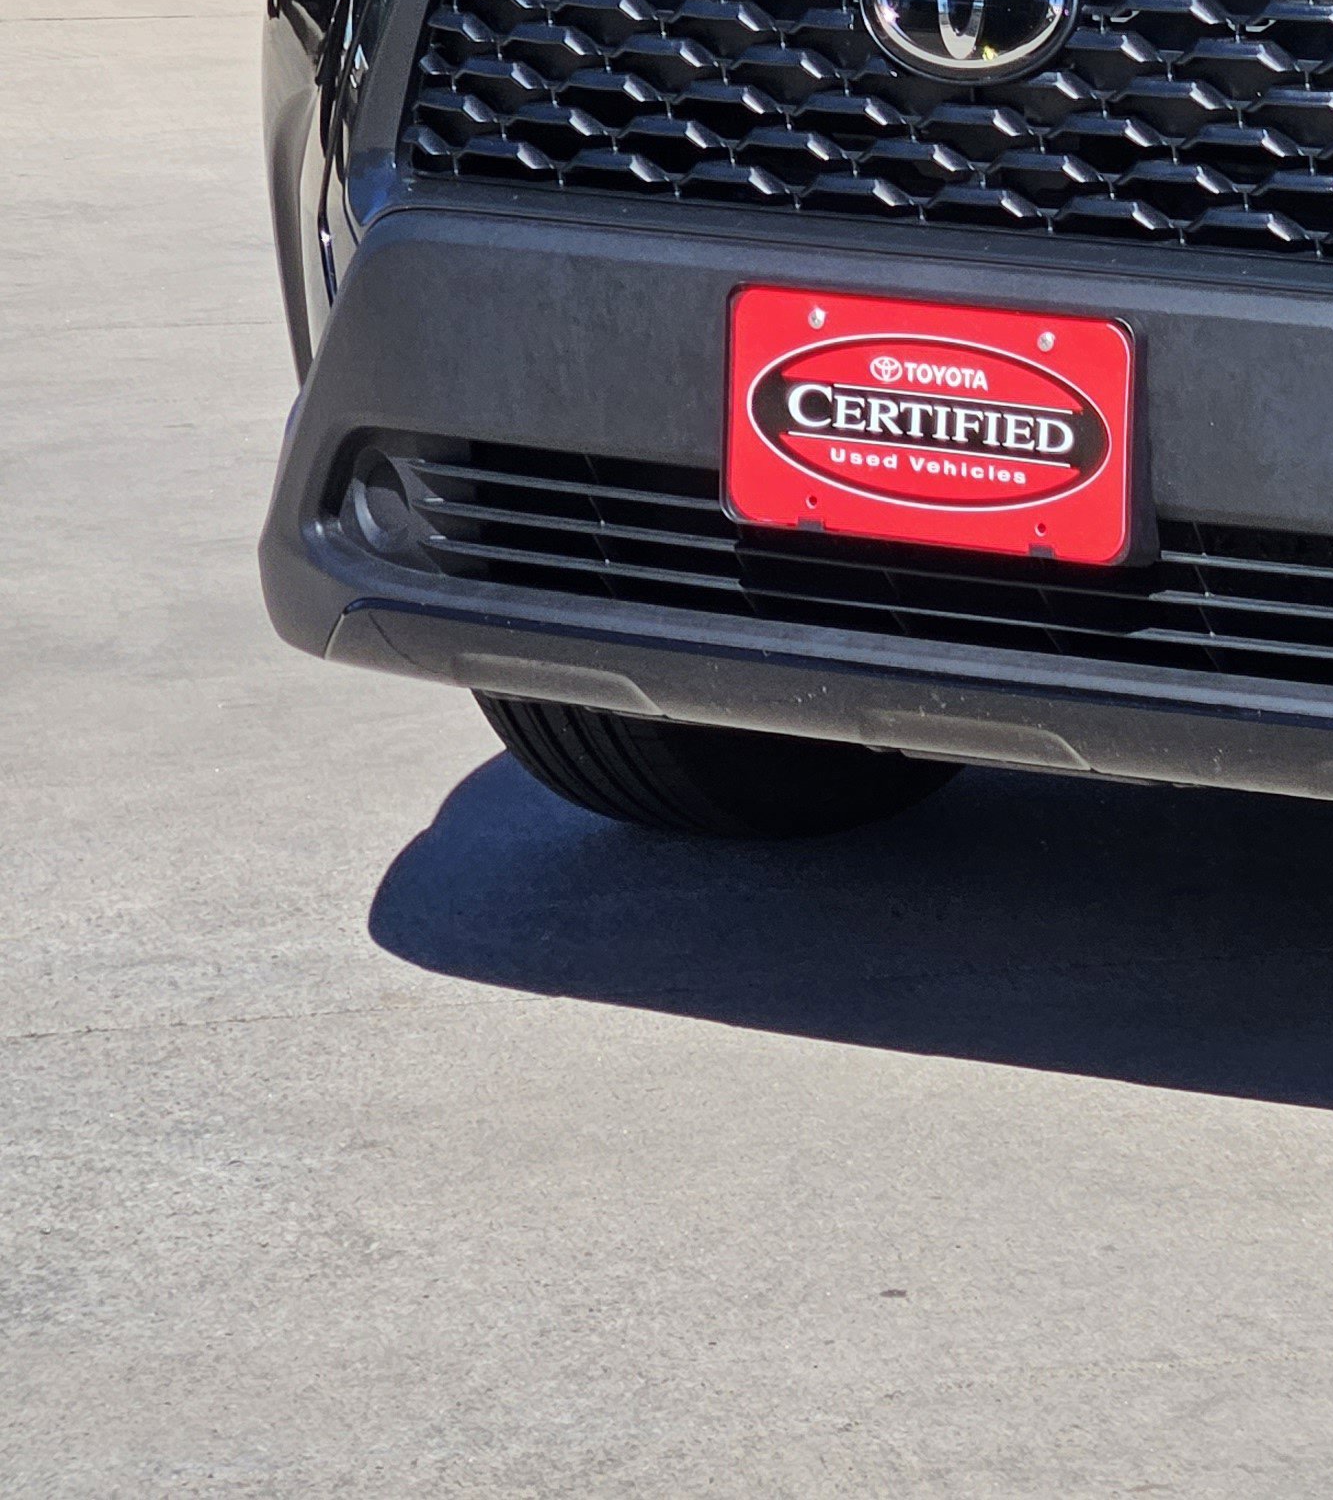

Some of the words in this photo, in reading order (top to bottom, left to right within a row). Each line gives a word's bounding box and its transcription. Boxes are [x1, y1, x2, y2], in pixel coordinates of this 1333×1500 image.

[906, 362, 989, 392] TOYOTA
[788, 384, 1075, 454] CERTIFIED
[829, 448, 898, 470] Used
[910, 456, 1028, 485] Vehicles
